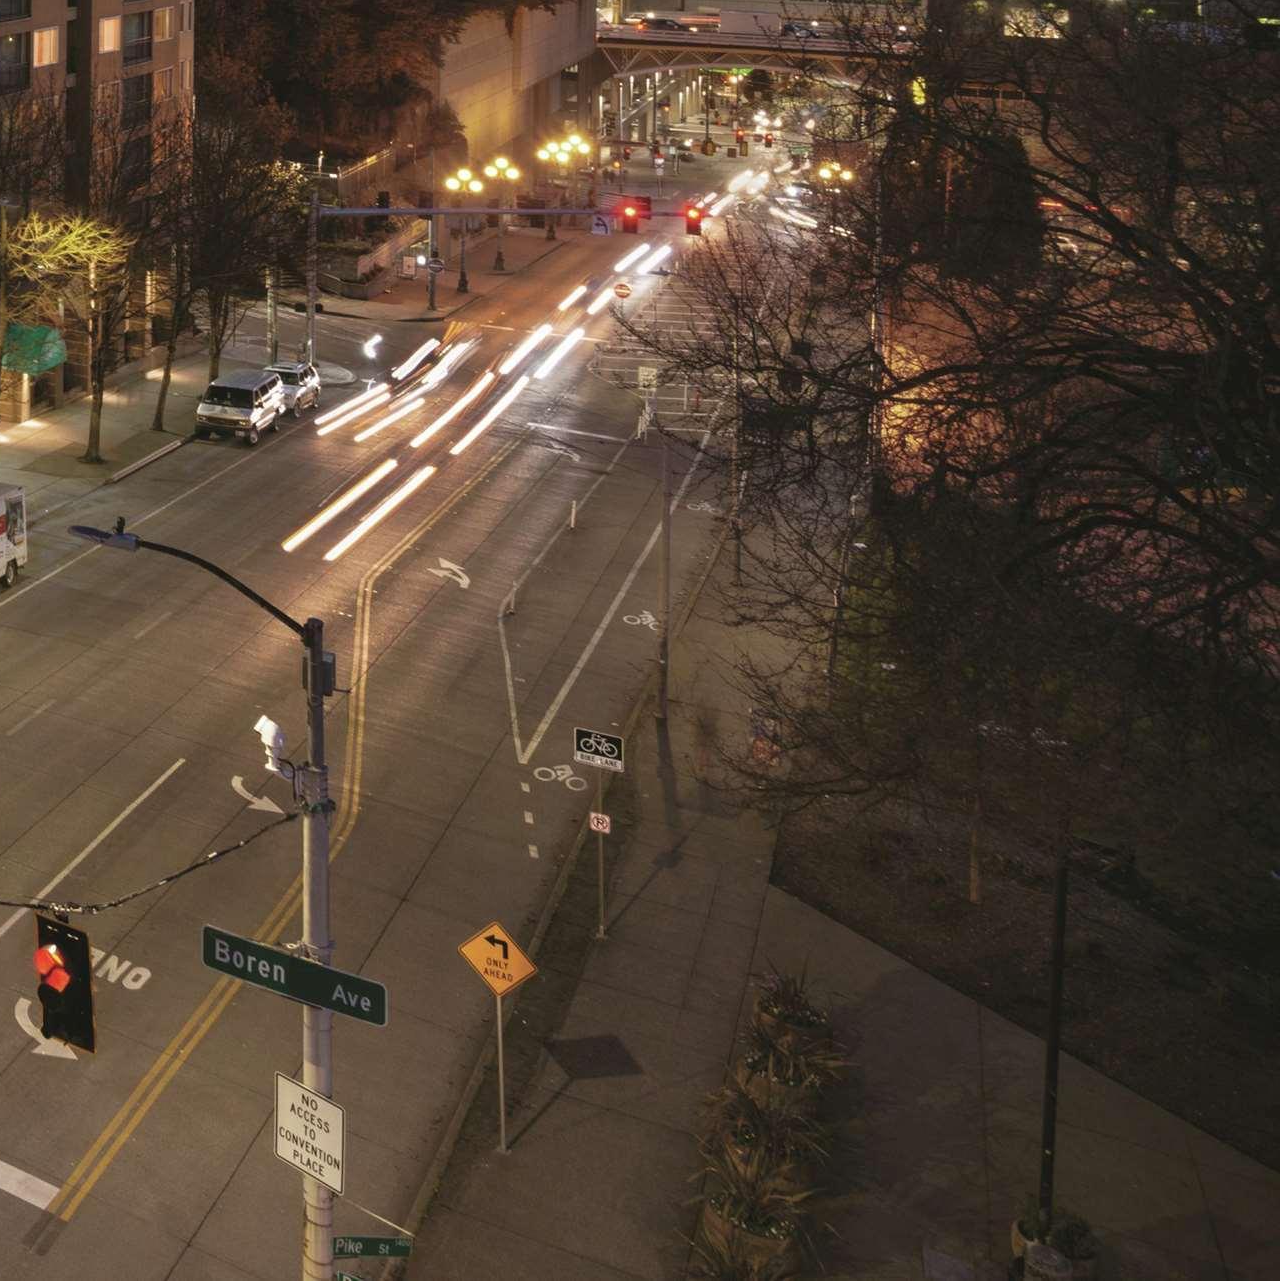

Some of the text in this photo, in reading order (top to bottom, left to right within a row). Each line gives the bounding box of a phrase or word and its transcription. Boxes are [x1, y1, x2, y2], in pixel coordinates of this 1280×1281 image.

[580, 752, 595, 762] BIKE
[486, 958, 508, 969] ONLY
[215, 938, 372, 1012] Boren Ave
[484, 968, 514, 982] AHEAD
[301, 1094, 318, 1111] NO
[290, 1102, 330, 1134] ACCESS
[303, 1124, 316, 1141] TO
[279, 1127, 340, 1171] CONVENTION
[293, 1150, 325, 1177] PLACE
[335, 1239, 363, 1254] Pike
[378, 1243, 390, 1255] St
